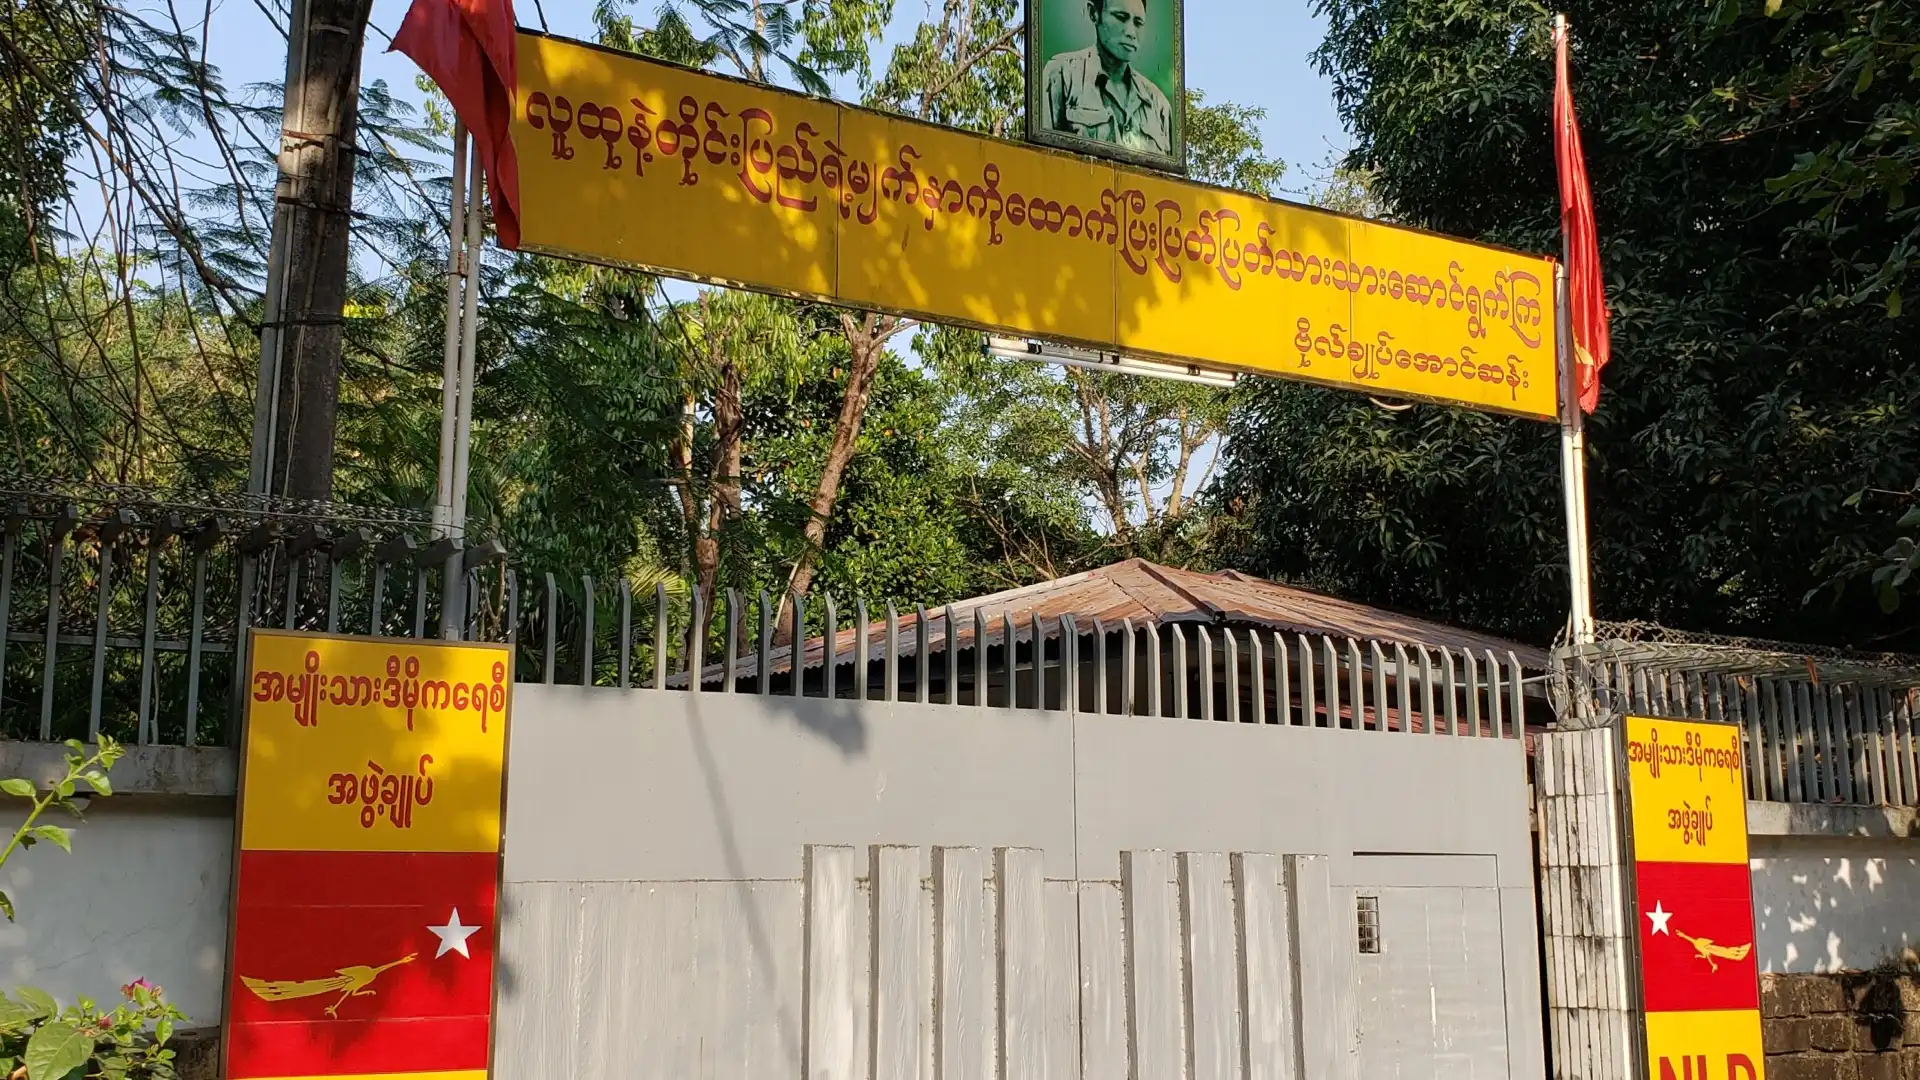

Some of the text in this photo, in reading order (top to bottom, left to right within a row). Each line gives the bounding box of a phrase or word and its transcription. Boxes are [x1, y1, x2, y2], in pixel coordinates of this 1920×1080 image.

[253, 650, 505, 733] အမျိုးသားဒီမိုကရေစီ
[1628, 728, 1740, 784] အမျိုးသားဒီမိုကရေစီ
[328, 753, 434, 828] အဖွဲ့ချုပ်
[1668, 795, 1713, 846] အဖွဲ့ချုပ်
